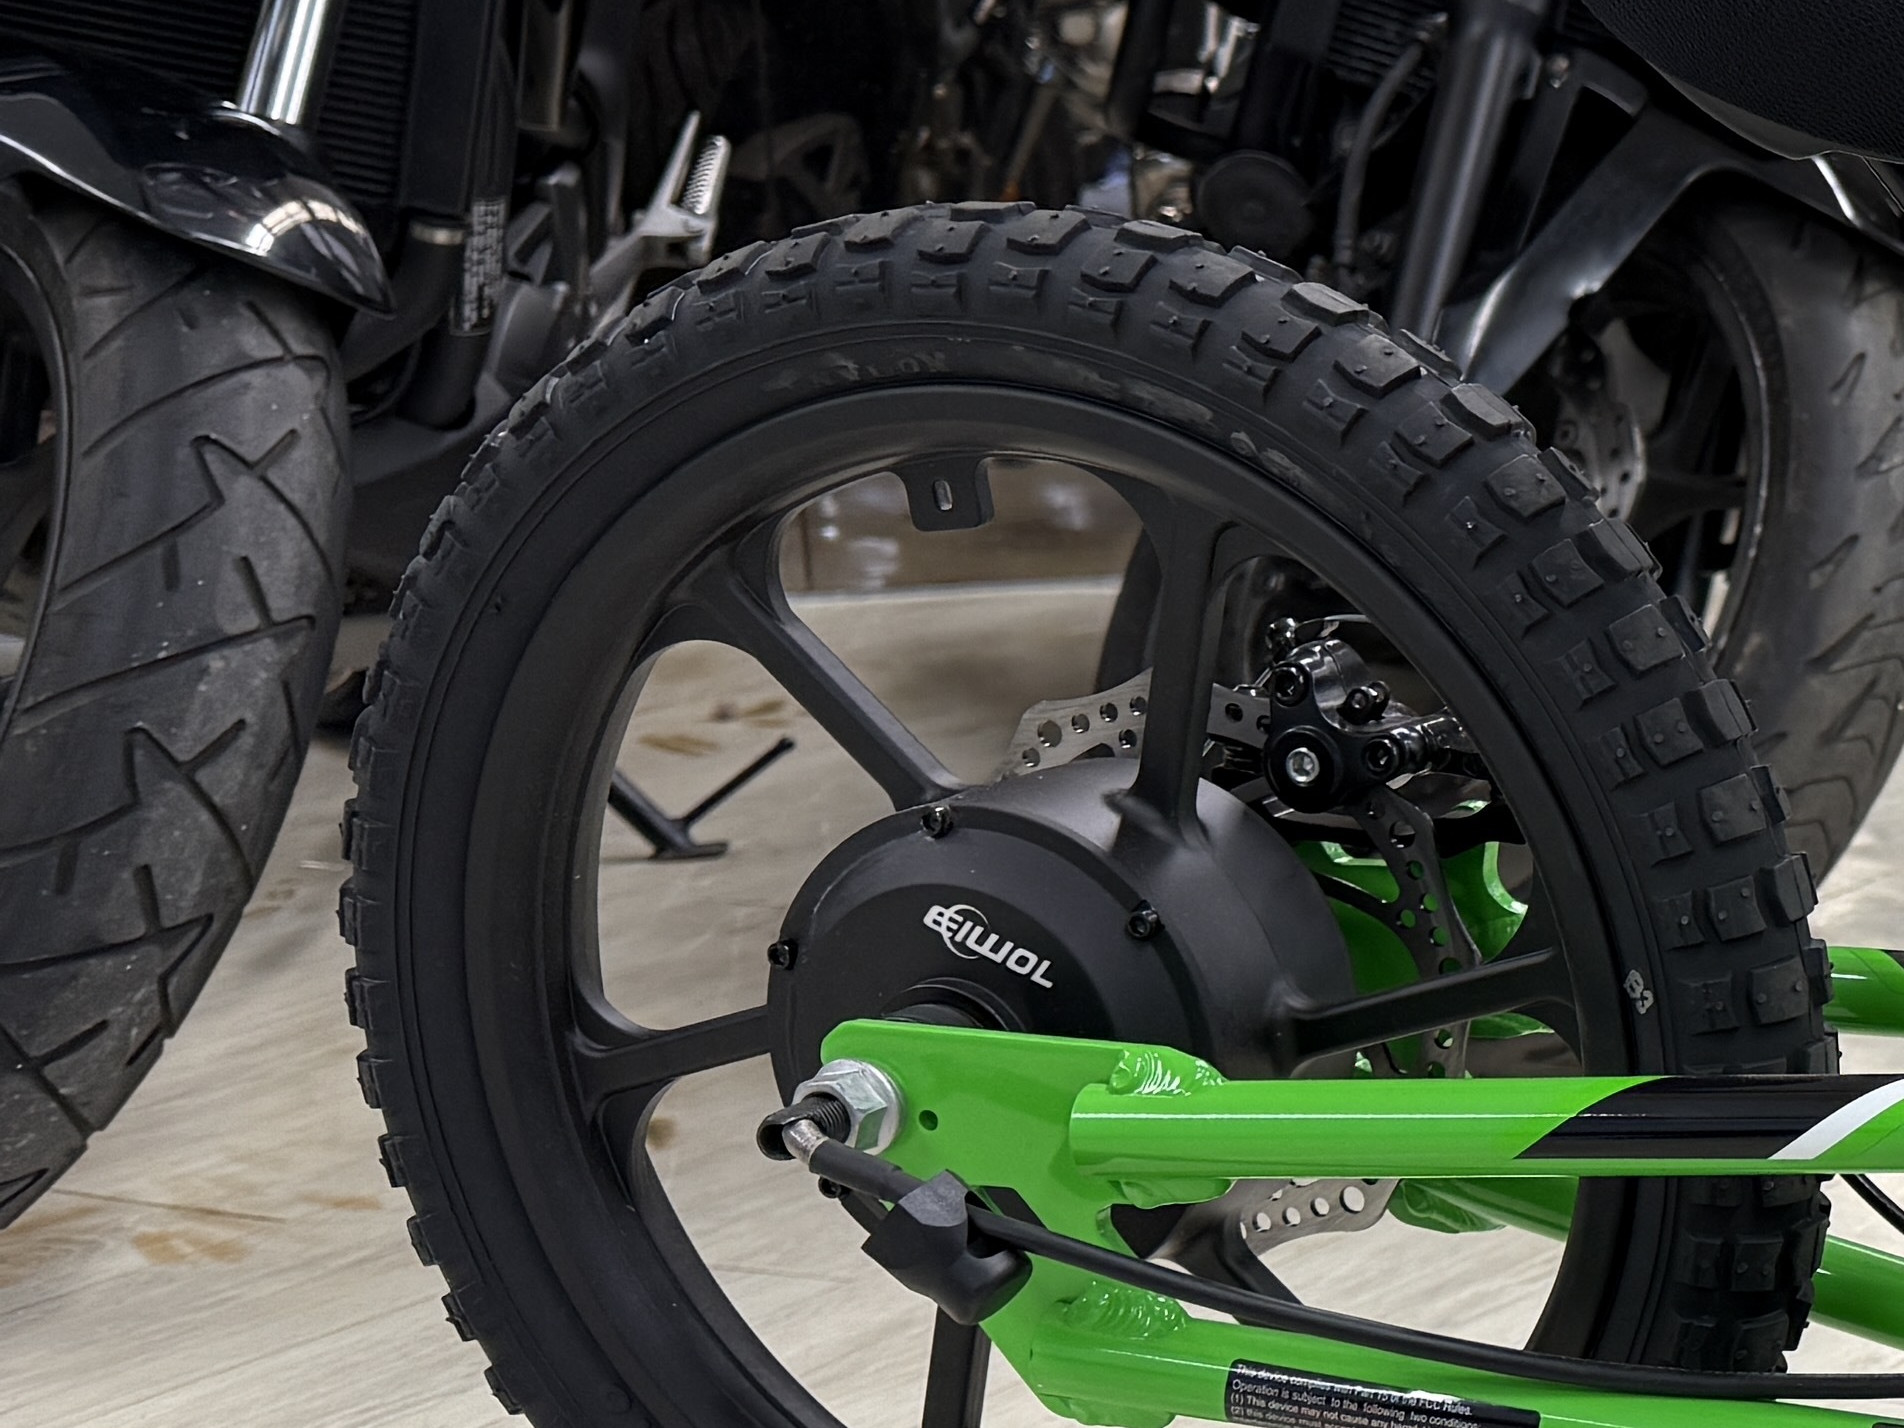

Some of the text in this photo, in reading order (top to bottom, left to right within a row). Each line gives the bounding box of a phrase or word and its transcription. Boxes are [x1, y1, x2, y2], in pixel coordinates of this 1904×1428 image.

[1231, 1393, 1244, 1405] (1)
[1246, 1395, 1266, 1408] This
[1268, 1400, 1298, 1414] device
[1300, 1407, 1321, 1419] may
[1323, 1410, 1339, 1421] not
[1340, 1414, 1369, 1426] cause
[1232, 1378, 1279, 1397] Operation
[1281, 1387, 1290, 1399] is
[1292, 1390, 1326, 1406] subject
[1342, 1399, 1358, 1411] the
[1363, 1402, 1406, 1421] following
[1410, 1411, 1427, 1422] two
